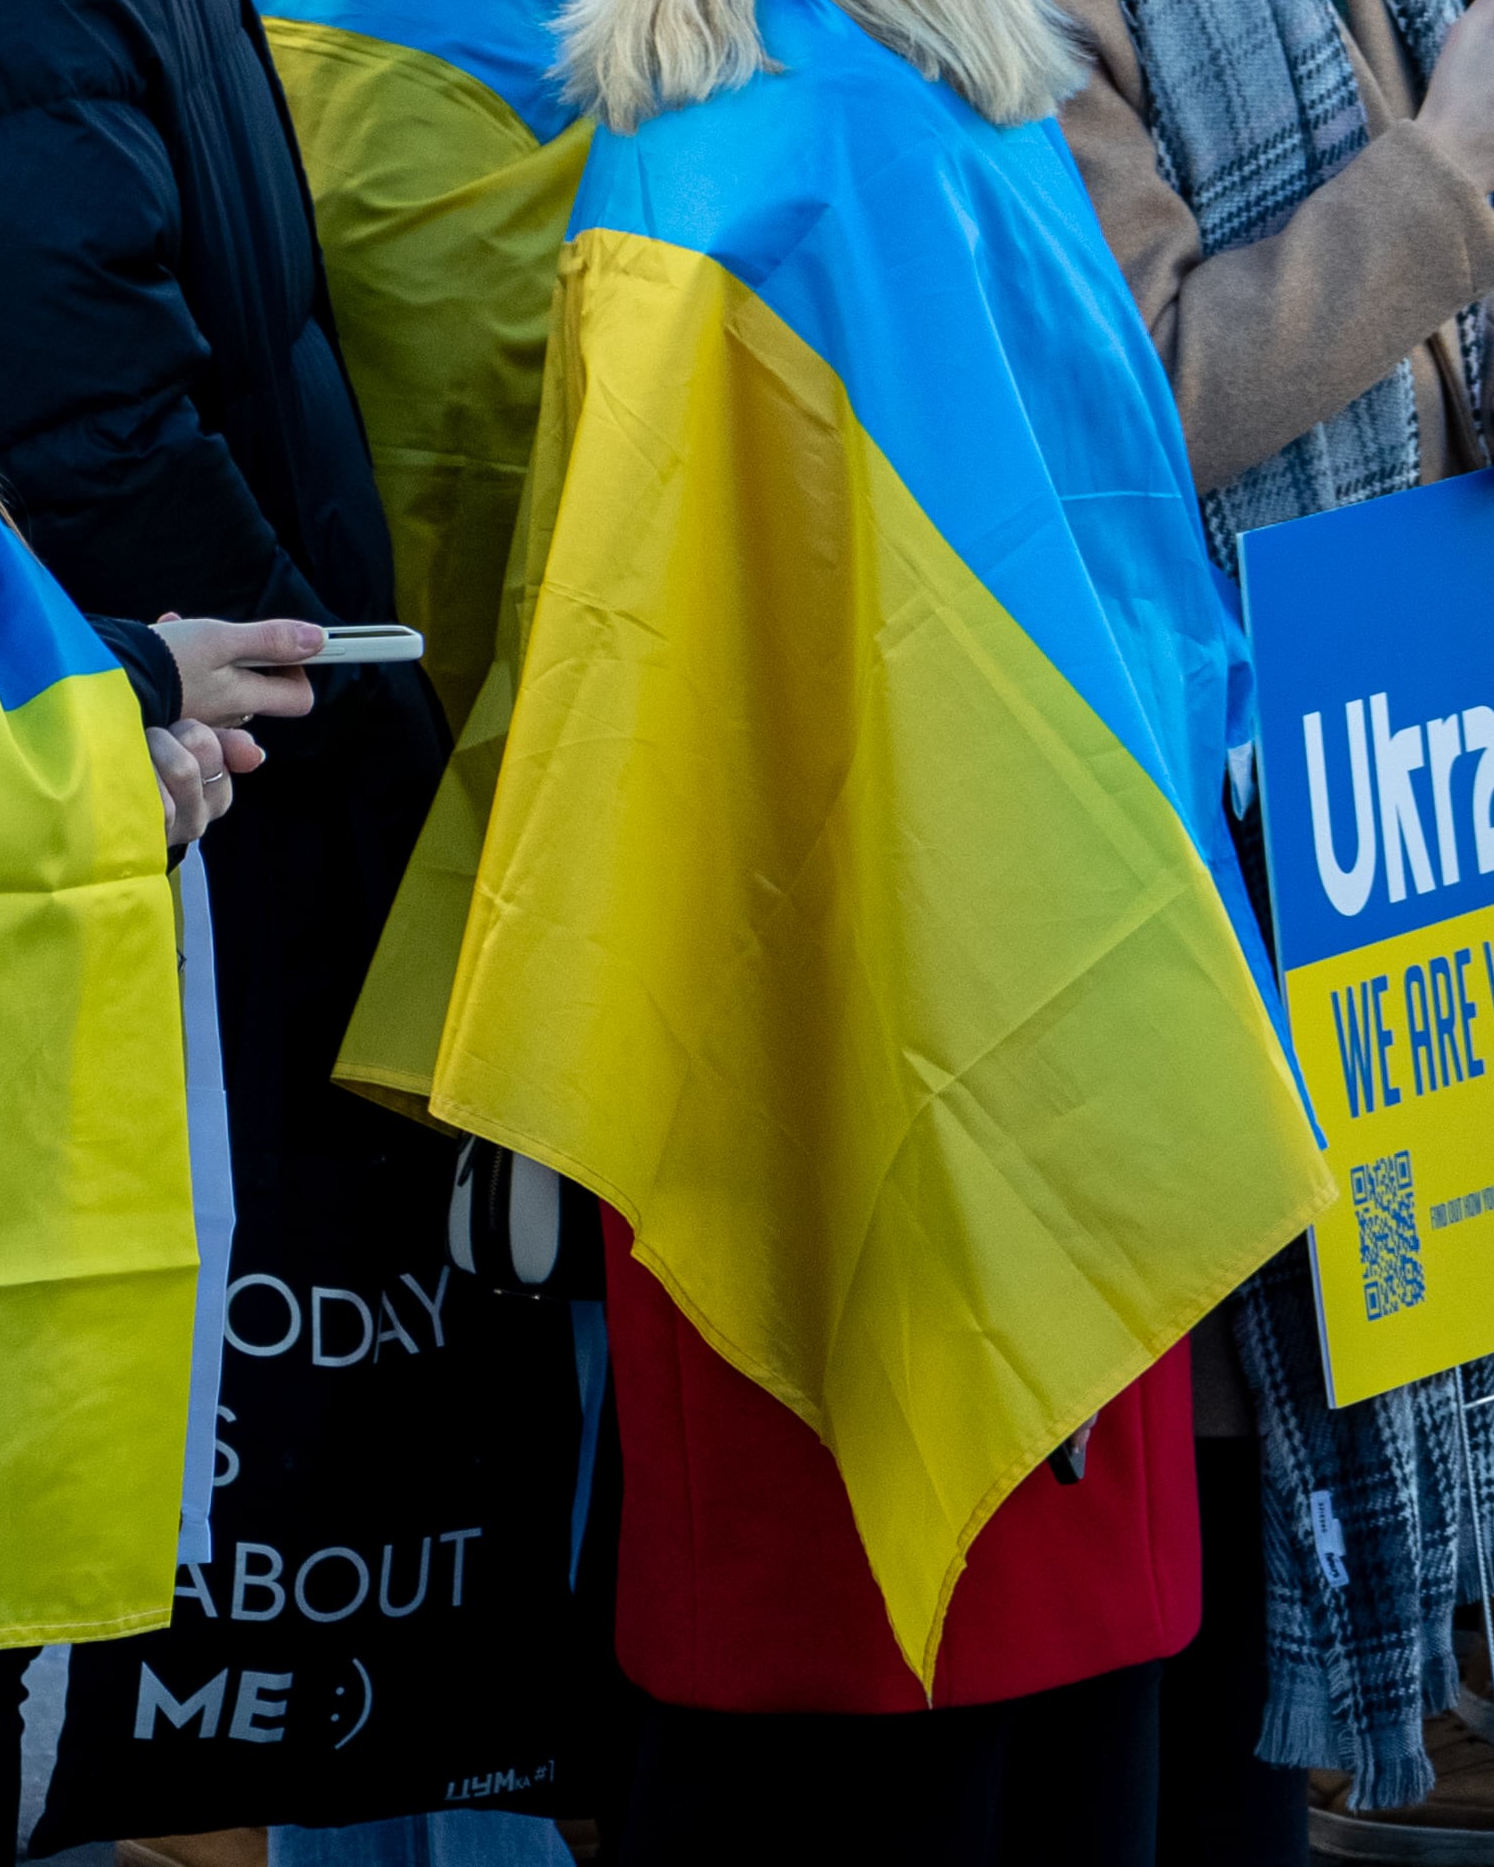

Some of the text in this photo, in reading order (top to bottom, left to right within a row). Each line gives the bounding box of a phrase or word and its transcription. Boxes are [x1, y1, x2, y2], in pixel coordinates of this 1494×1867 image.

[1331, 974, 1401, 1119] WE
[1403, 947, 1485, 1097] ARE
[224, 1266, 450, 1367] ODAY
[212, 1404, 240, 1488] S
[133, 1661, 294, 1744] ME
